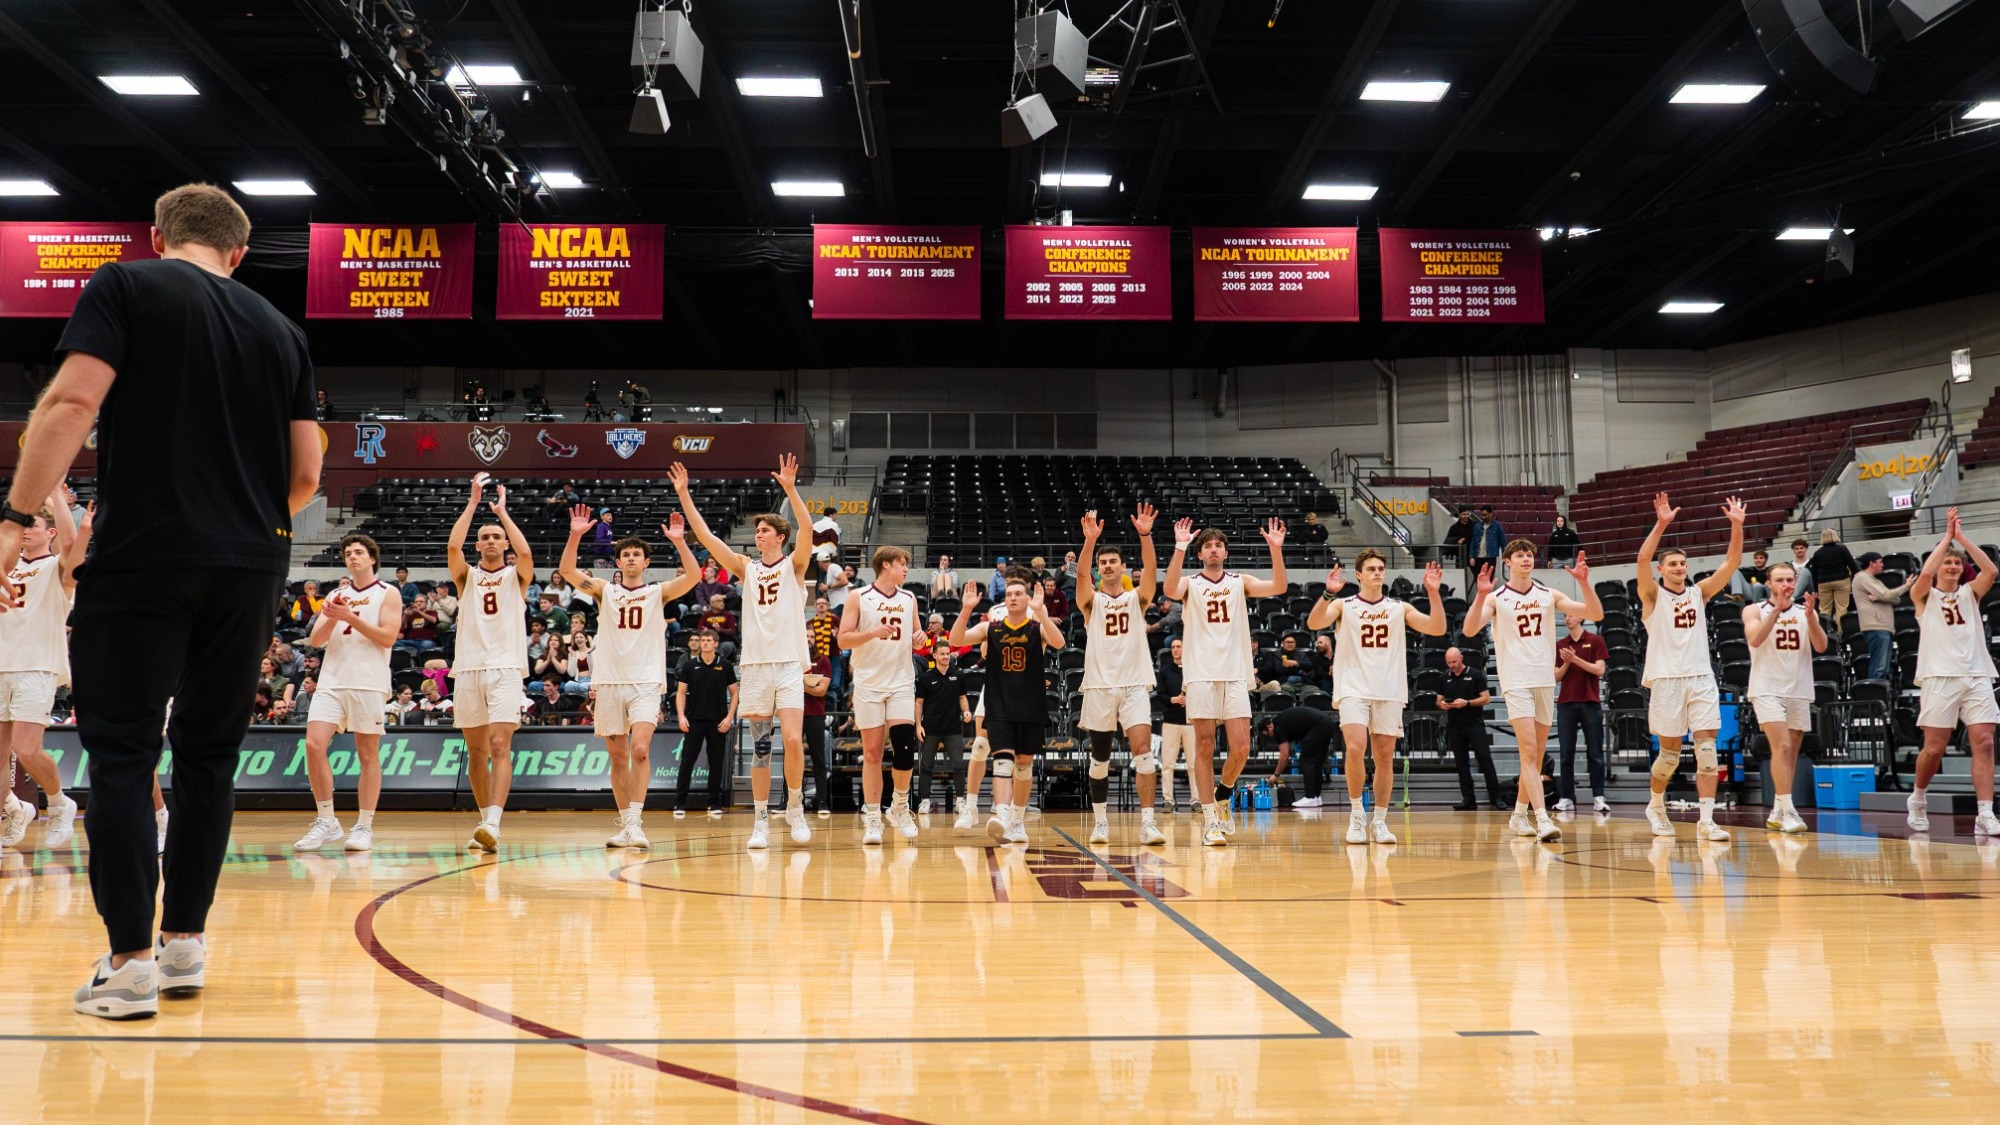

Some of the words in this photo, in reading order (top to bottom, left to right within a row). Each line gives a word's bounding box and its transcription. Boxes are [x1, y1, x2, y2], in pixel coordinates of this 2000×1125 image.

[28, 235, 71, 243] WOMEN'S
[73, 235, 132, 243] BASKETBALL
[343, 228, 442, 258] NCAA
[531, 228, 631, 258] NCAA
[852, 235, 882, 243] MEN'S
[884, 235, 942, 243] VOLLEYBALL
[1042, 238, 1072, 247] MEN'S
[1075, 238, 1132, 247] VOLLEYBALL
[1223, 238, 1266, 246] WOMEN'S
[1269, 238, 1326, 246] VOLLEYBALL
[37, 244, 123, 257] CONFERENCE
[867, 245, 975, 259] TOURNAMENT
[1044, 248, 1131, 260] CONFERENCE
[1246, 248, 1349, 261] TOURNAMENT
[1420, 251, 1503, 263] CONFERENCE
[340, 260, 374, 270] MEN'S
[377, 260, 442, 270] BASKETBALL
[529, 260, 564, 269] MEN'S
[566, 260, 632, 269] BASKETBALL
[1048, 261, 1128, 273] CHAMPIONS
[1425, 264, 1500, 276] CHAMPIONS
[548, 271, 614, 287] SWEET
[834, 268, 860, 278] 2013
[867, 268, 892, 278] 2014
[900, 268, 925, 278] 2015
[930, 268, 955, 278] 2025
[1222, 271, 1246, 280] 1995
[1249, 271, 1274, 280] 1999
[1279, 271, 1304, 280] 2000
[1306, 271, 1331, 280] 2004
[358, 271, 424, 288] SWEET
[1122, 283, 1146, 293] 2013
[1222, 282, 1246, 291] 2005
[1250, 282, 1274, 291] 2022
[1279, 282, 1304, 291] 2024
[1410, 286, 1434, 295] 1983
[1438, 286, 1462, 295] 1984
[1466, 286, 1490, 295] 1992
[1493, 286, 1517, 295] 1995
[350, 290, 430, 308] SIXTEEN
[539, 291, 621, 307] SIXTEEN
[1026, 294, 1051, 304] 2014
[1092, 294, 1117, 304] 2025
[1410, 297, 1434, 306] 1999
[1438, 297, 1463, 306] 2000
[1466, 297, 1490, 306] 2004
[1493, 297, 1517, 306] 2005
[374, 308, 405, 319] 1985
[564, 307, 595, 318] 2021
[1410, 308, 1435, 317] 2021
[1439, 308, 1463, 317] 2022
[1467, 308, 1491, 317] 2024
[609, 433, 643, 442] BILLIKENS
[681, 437, 710, 451] VCU
[758, 582, 780, 605] 15
[1202, 588, 1231, 599] Loyola
[484, 592, 498, 615] 8
[876, 602, 905, 614] Loyola
[1513, 600, 1542, 612] Loyola
[1207, 599, 1231, 623] 21
[1359, 609, 1390, 621] Loyola
[1941, 604, 1966, 626] 31
[618, 606, 643, 630] 10
[1105, 612, 1129, 636] 20
[1674, 607, 1697, 629] 28
[1516, 613, 1542, 638] 27
[1361, 624, 1389, 648] 22
[1776, 629, 1800, 650] 29
[1002, 646, 1026, 672] 19
